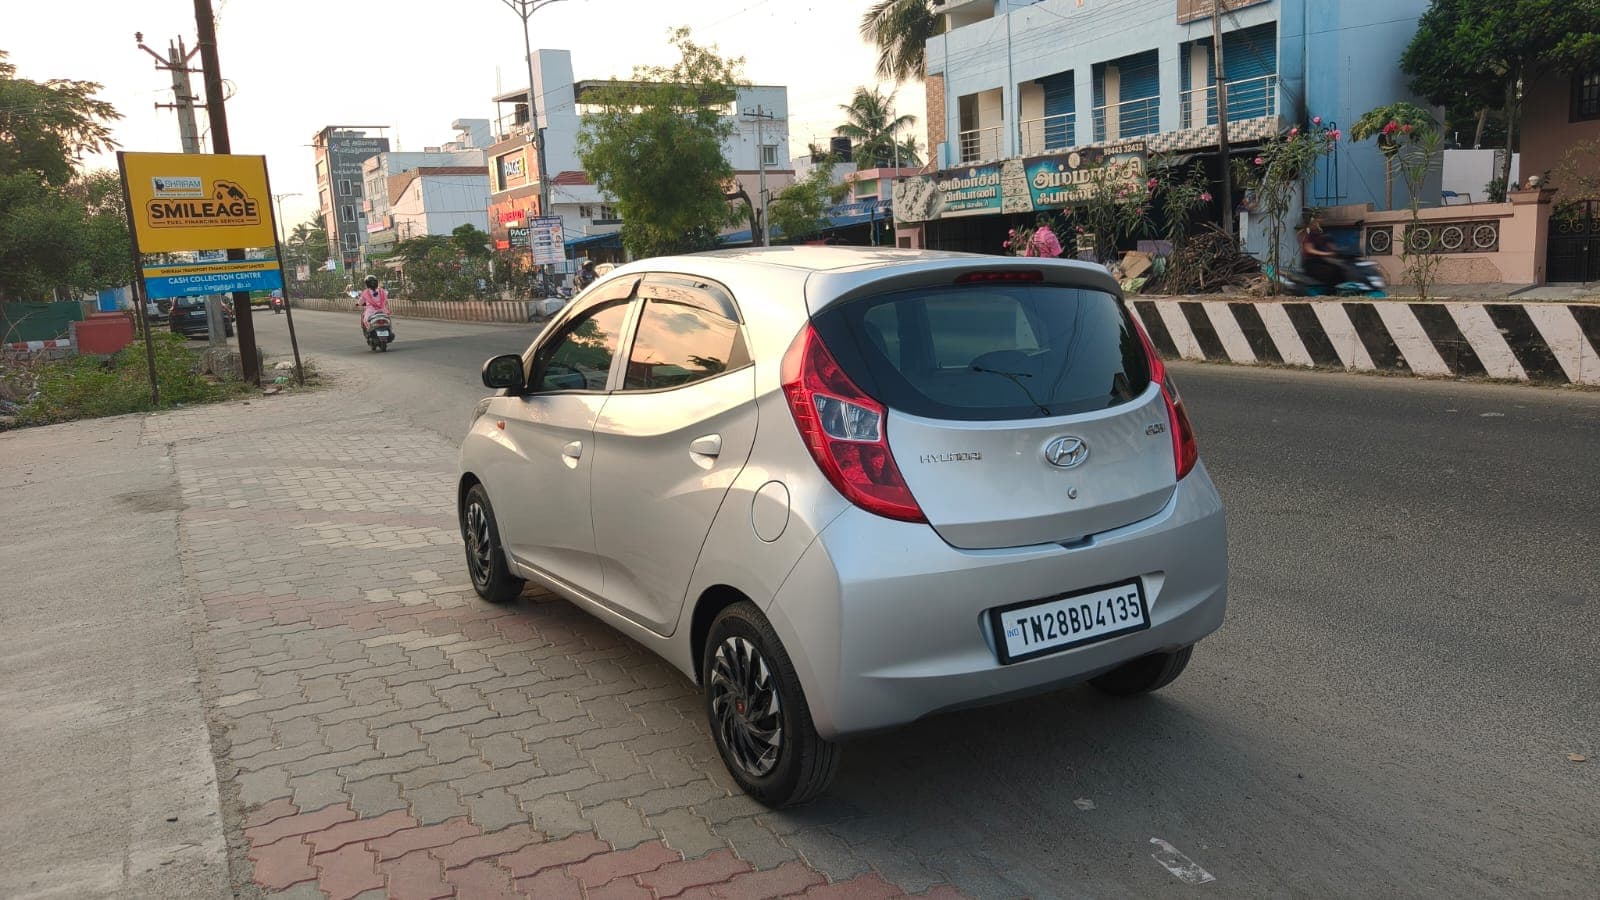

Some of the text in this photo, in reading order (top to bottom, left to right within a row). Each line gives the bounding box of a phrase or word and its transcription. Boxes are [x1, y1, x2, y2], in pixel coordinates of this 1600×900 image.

[150, 202, 257, 219] SMILEAGE
[168, 272, 262, 285] CASH COLLECTION CENTRE
[919, 452, 982, 464] HYUNDAI
[1017, 592, 1140, 645] TN28BD4135
